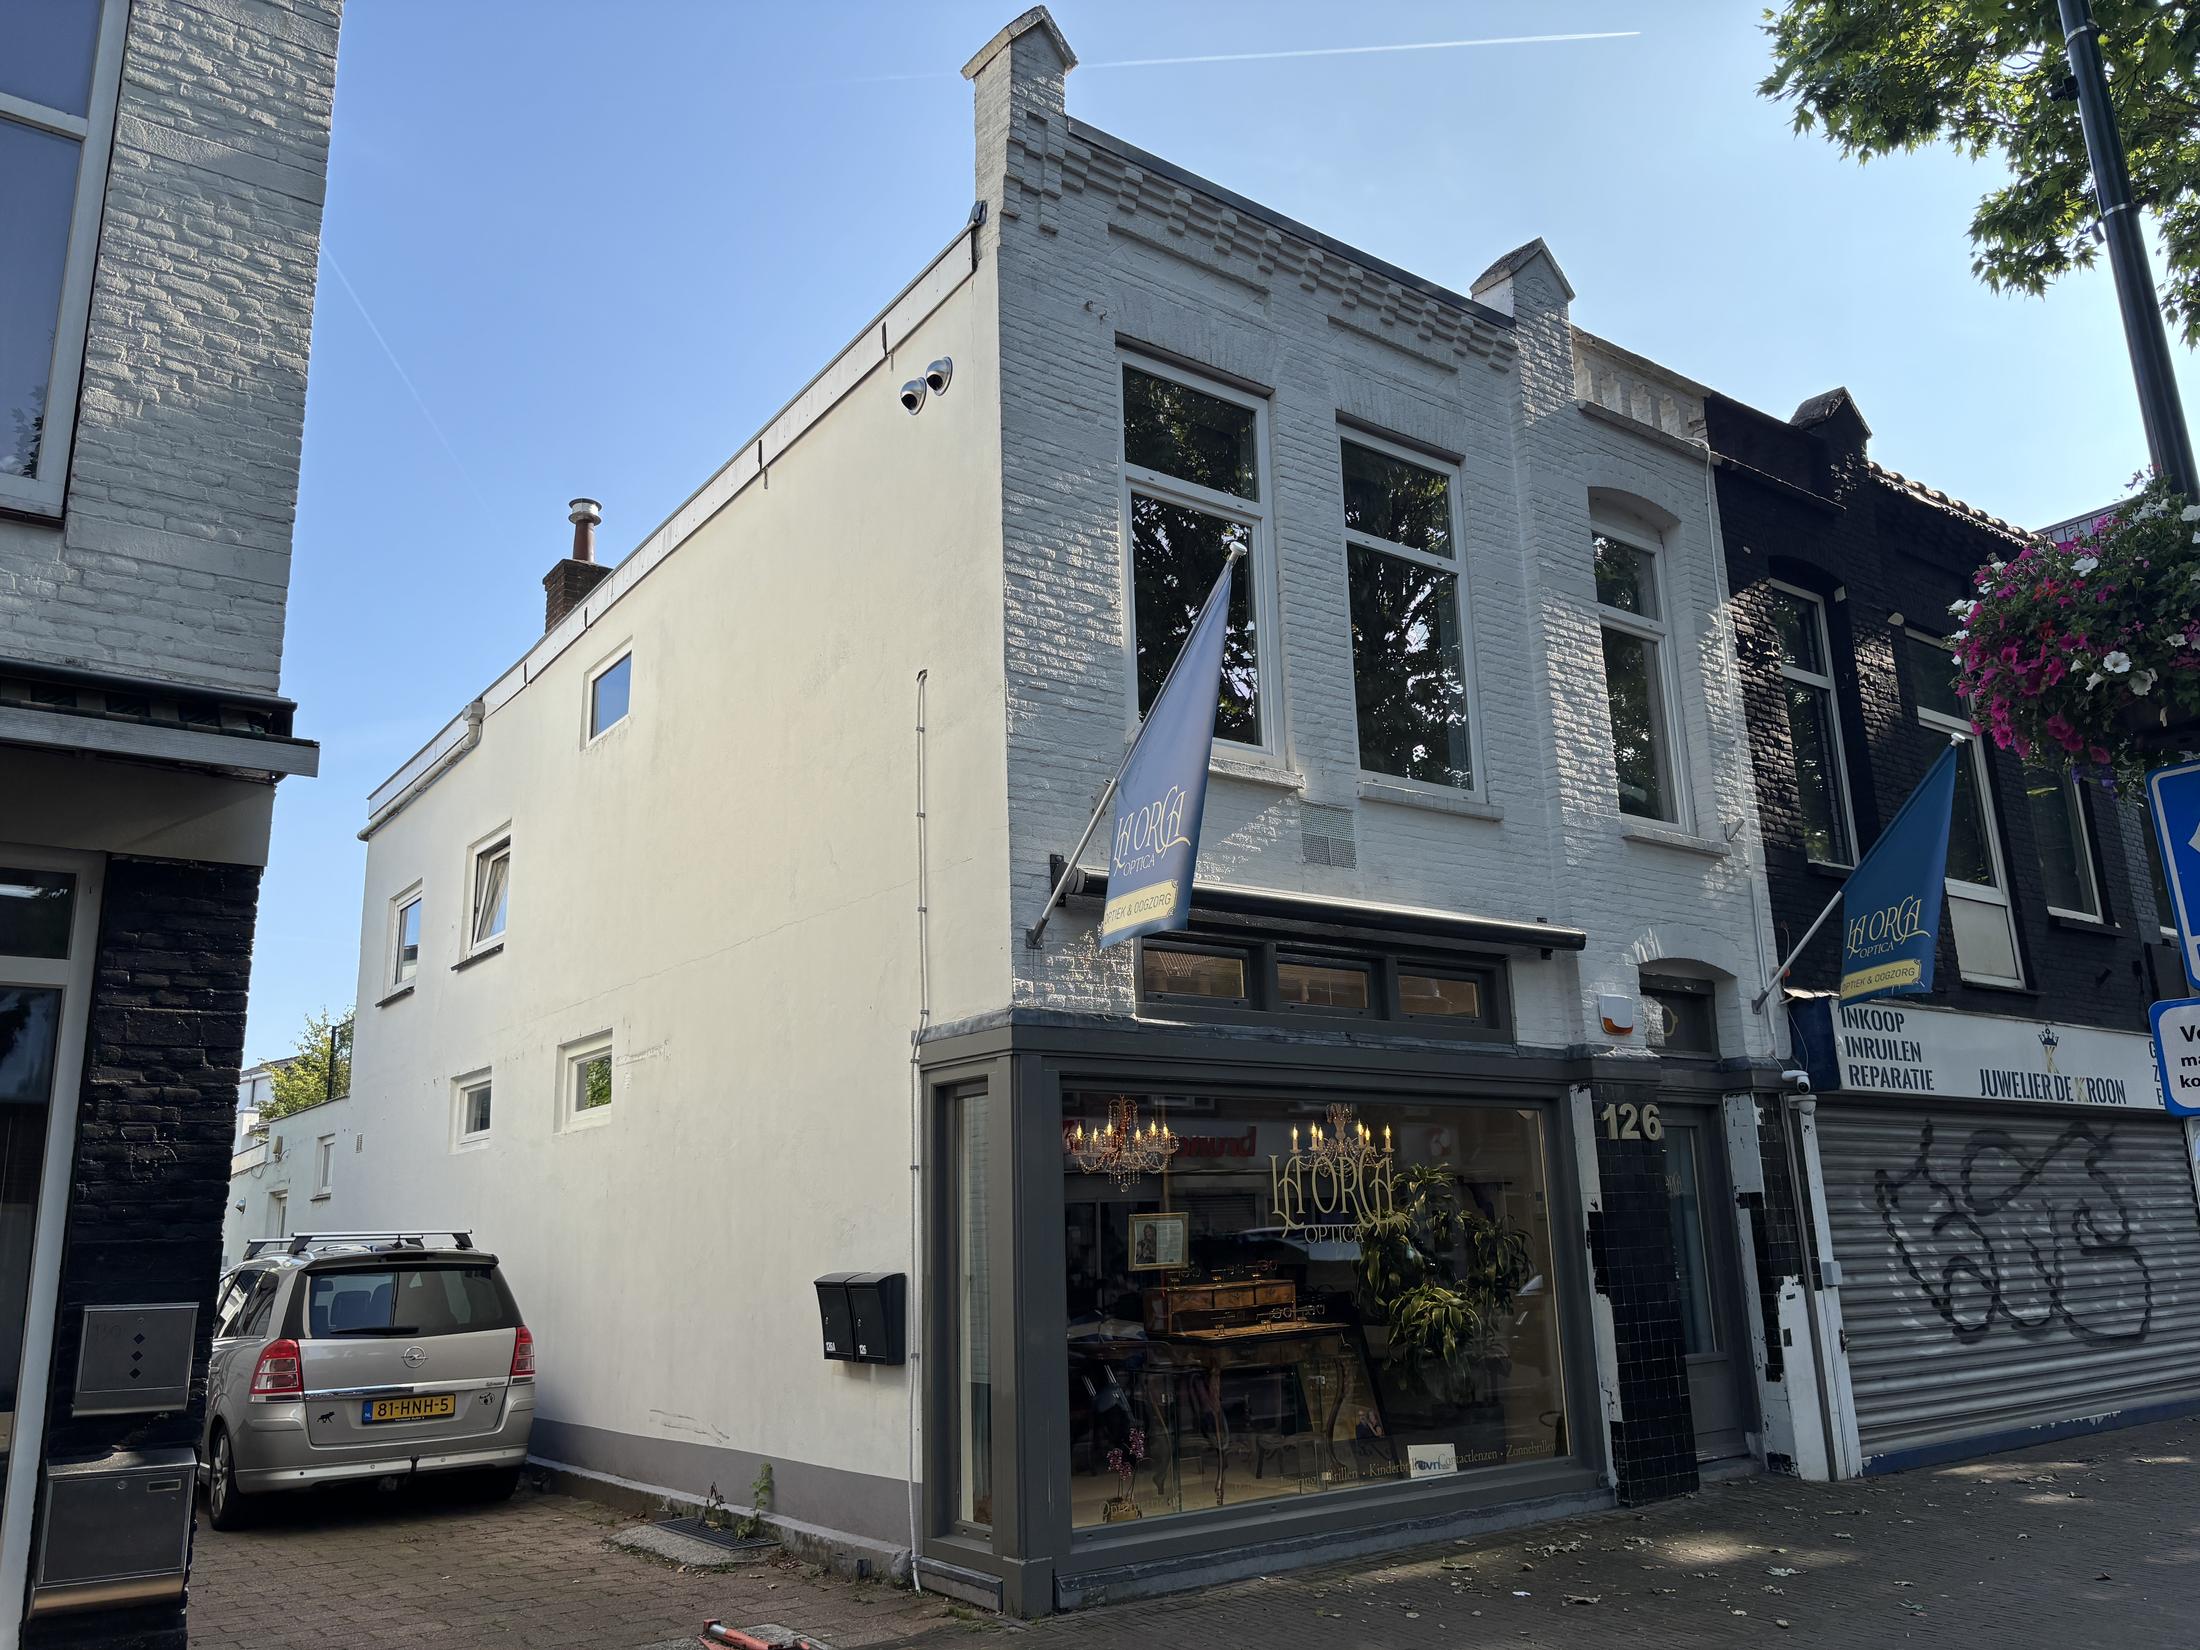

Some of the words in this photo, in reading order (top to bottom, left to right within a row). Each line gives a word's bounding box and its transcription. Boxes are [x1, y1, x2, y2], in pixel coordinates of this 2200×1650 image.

[1123, 853, 1155, 876] OPTICA
[1104, 905, 1127, 925] OPTIEK
[1127, 904, 1133, 916] &
[1134, 893, 1172, 914] OOGZORG
[1860, 941, 1894, 958] OPTICA
[1867, 975, 1873, 985] &
[1874, 967, 1915, 982] OOGZORG
[1841, 1007, 1905, 1033] INKOOP
[1845, 1036, 1922, 1063] INRUILEN
[1849, 1064, 1934, 1090] REPARATIE
[1980, 1069, 2053, 1100] JUWELIER
[2054, 1075, 2074, 1102] DE
[2074, 1076, 2127, 1104] KROON
[1601, 1103, 1662, 1141] 126
[1304, 1225, 1364, 1243] OPTICA
[377, 1397, 449, 1417] 81-HNH-5
